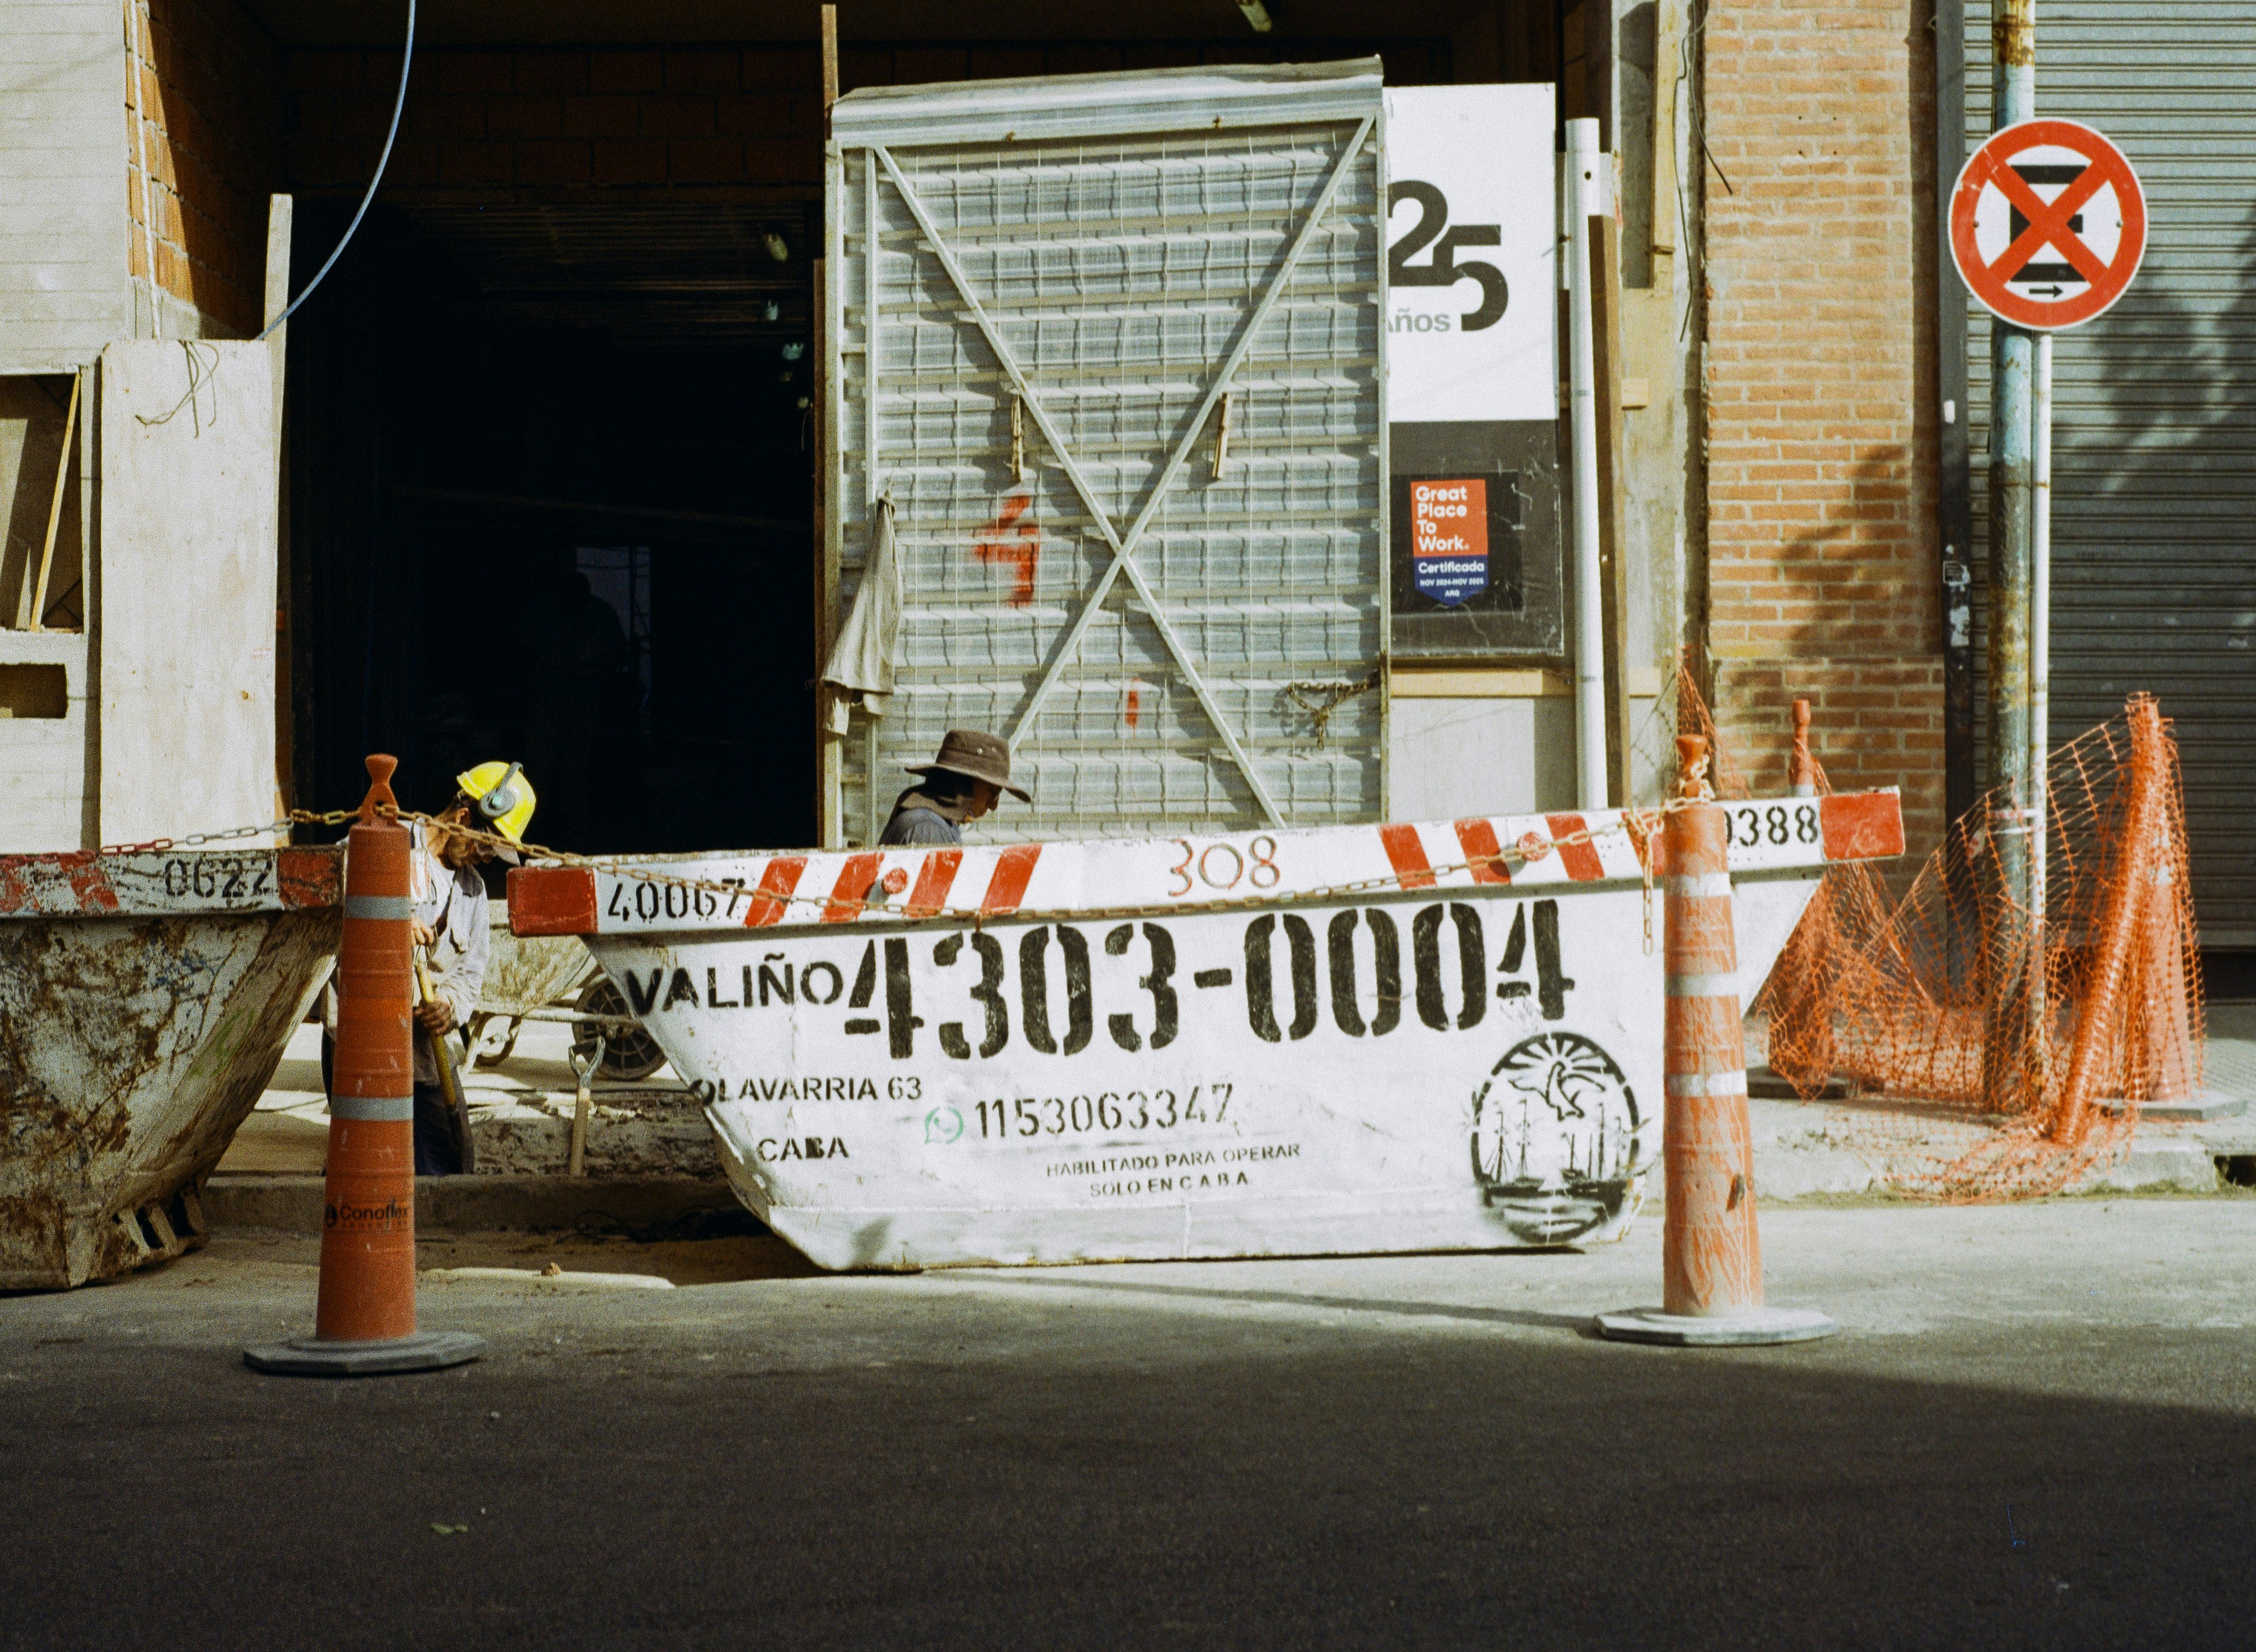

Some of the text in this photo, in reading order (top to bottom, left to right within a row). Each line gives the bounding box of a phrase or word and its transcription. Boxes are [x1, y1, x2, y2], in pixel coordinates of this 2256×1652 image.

[1387, 180, 1508, 331] 25
[1415, 486, 1467, 502] Great
[1418, 503, 1467, 518] Place
[1417, 520, 1437, 535] To
[1418, 560, 1485, 574] Certificada
[1167, 835, 1281, 897] 308
[608, 878, 745, 922] 40067
[620, 953, 843, 1016] VALIÑO
[844, 899, 1575, 1060] 4303-0004
[690, 1076, 922, 1106] OLAVARRIA 63
[975, 1083, 1232, 1139] 1153063347
[756, 1136, 849, 1162] CABA
[1047, 1143, 1301, 1177] HABILITADO PARA OPERAR
[1090, 1180, 1141, 1197] SOLO
[1148, 1177, 1173, 1192] EN
